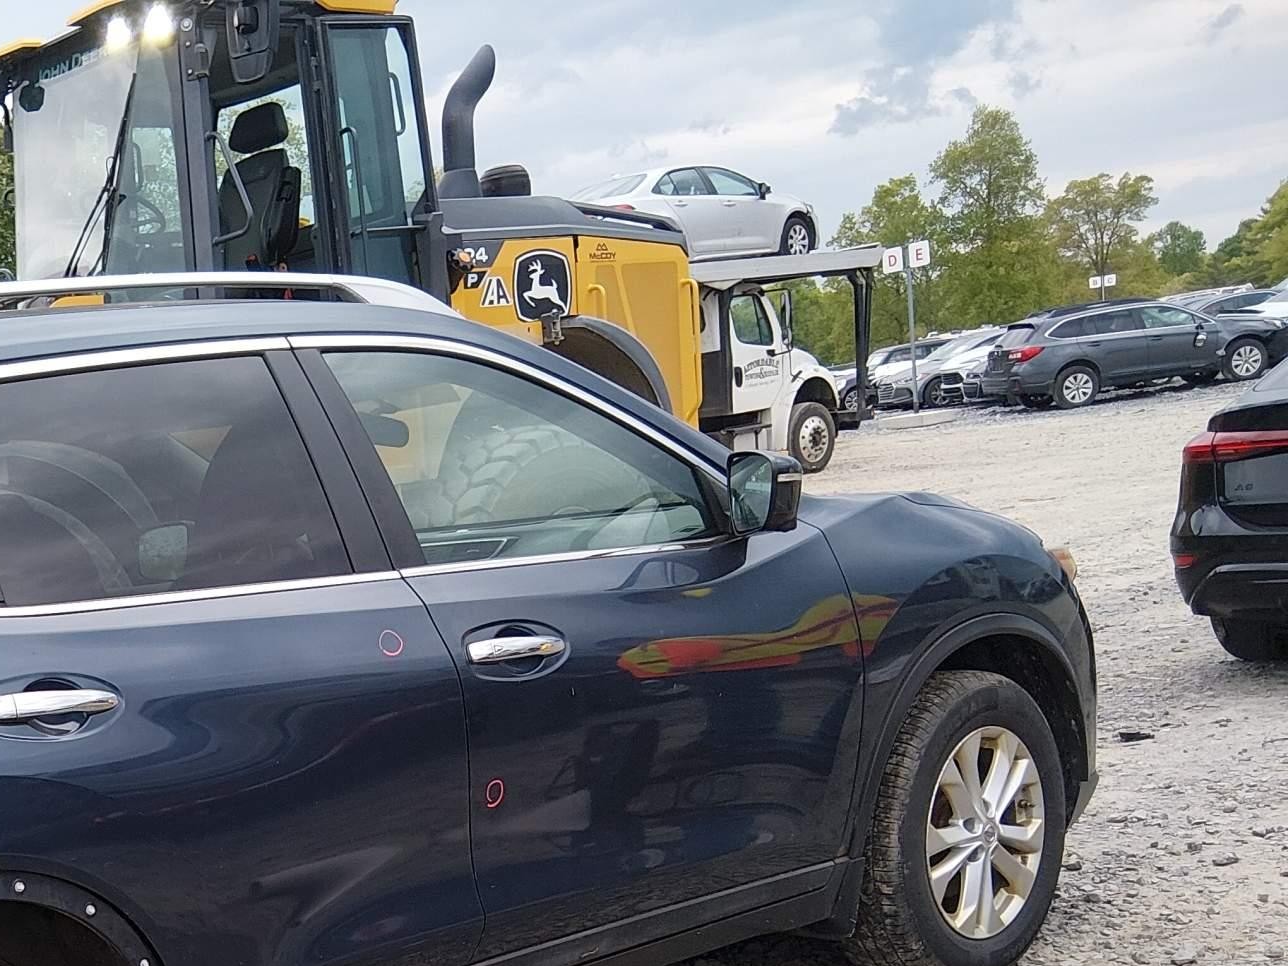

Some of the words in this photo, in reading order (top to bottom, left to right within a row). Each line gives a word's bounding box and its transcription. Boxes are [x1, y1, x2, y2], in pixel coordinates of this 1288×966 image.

[38, 60, 70, 81] JOHN
[887, 254, 898, 267] D
[915, 248, 924, 261] E
[467, 273, 479, 288] P
